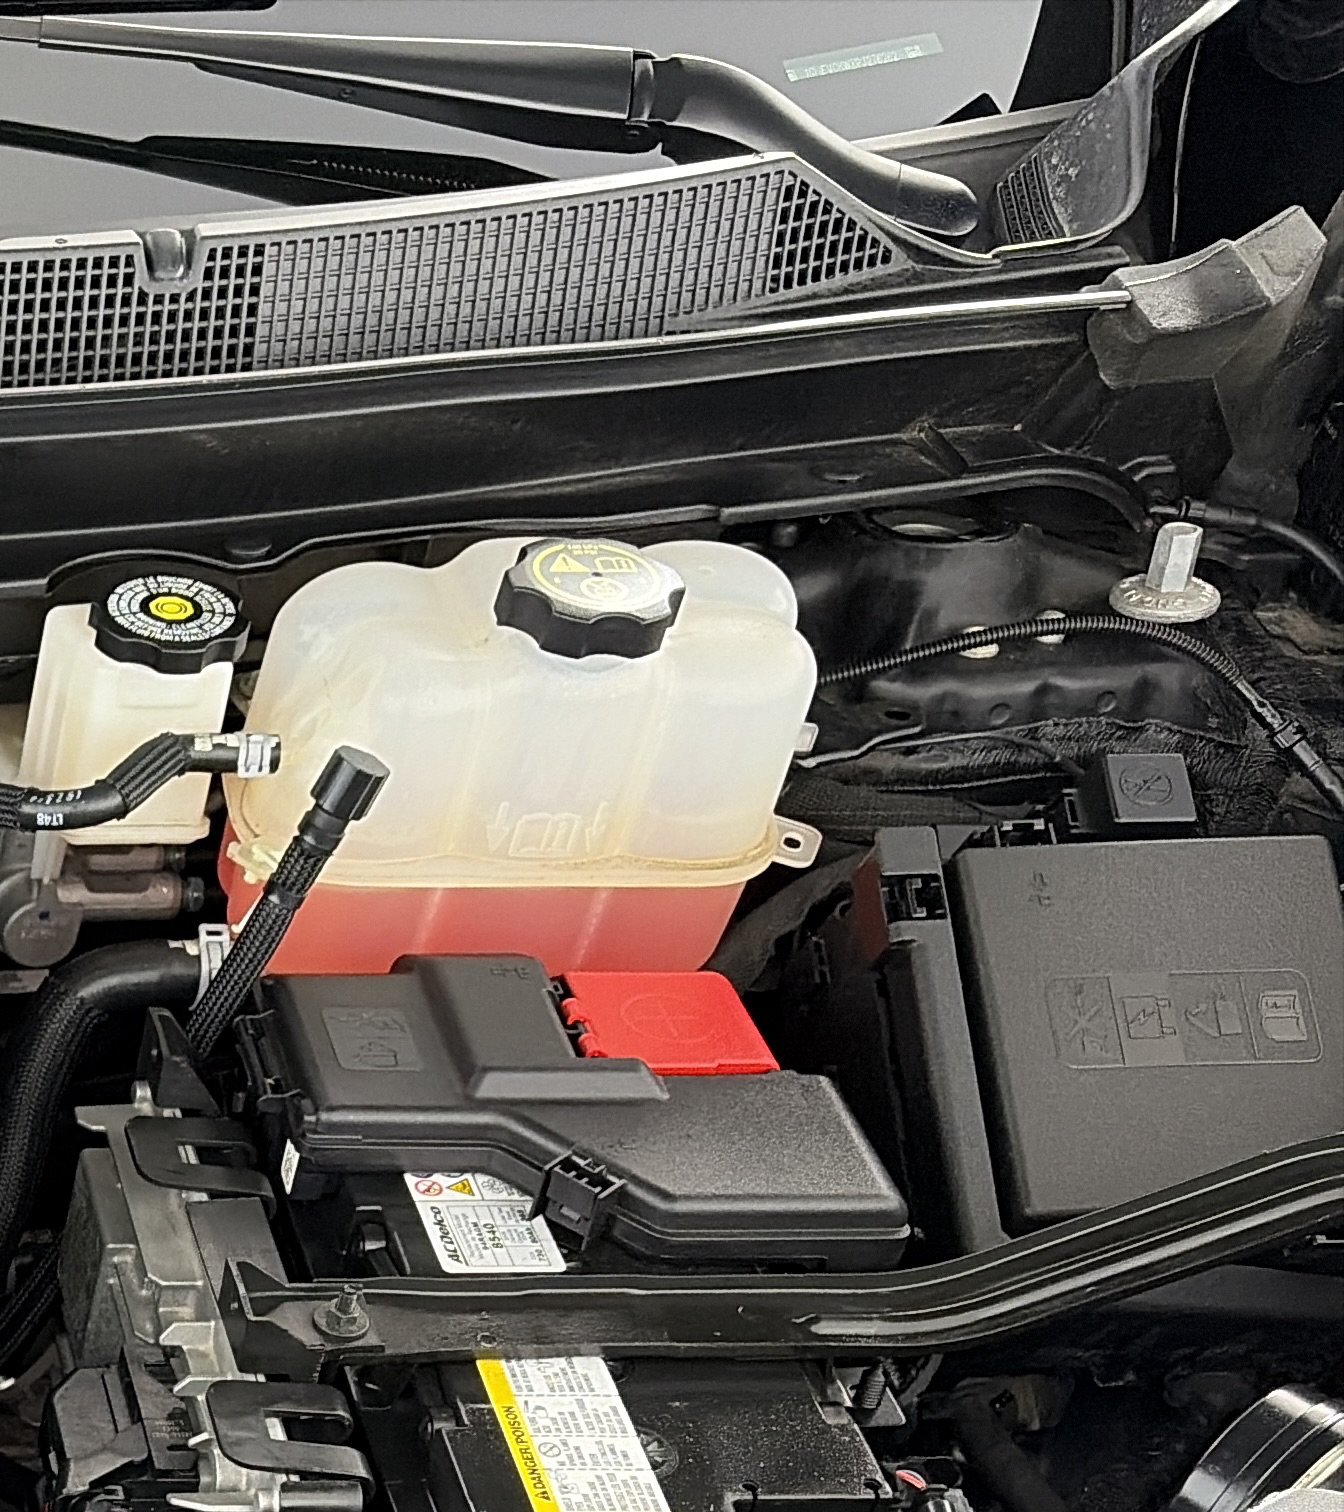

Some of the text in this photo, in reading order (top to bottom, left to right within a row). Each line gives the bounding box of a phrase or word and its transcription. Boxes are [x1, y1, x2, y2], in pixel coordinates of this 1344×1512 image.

[36, 812, 64, 826] LT48
[430, 1206, 463, 1264] ACDelco
[483, 1222, 504, 1250] 8540
[501, 1405, 547, 1491] DANGER/POISON
